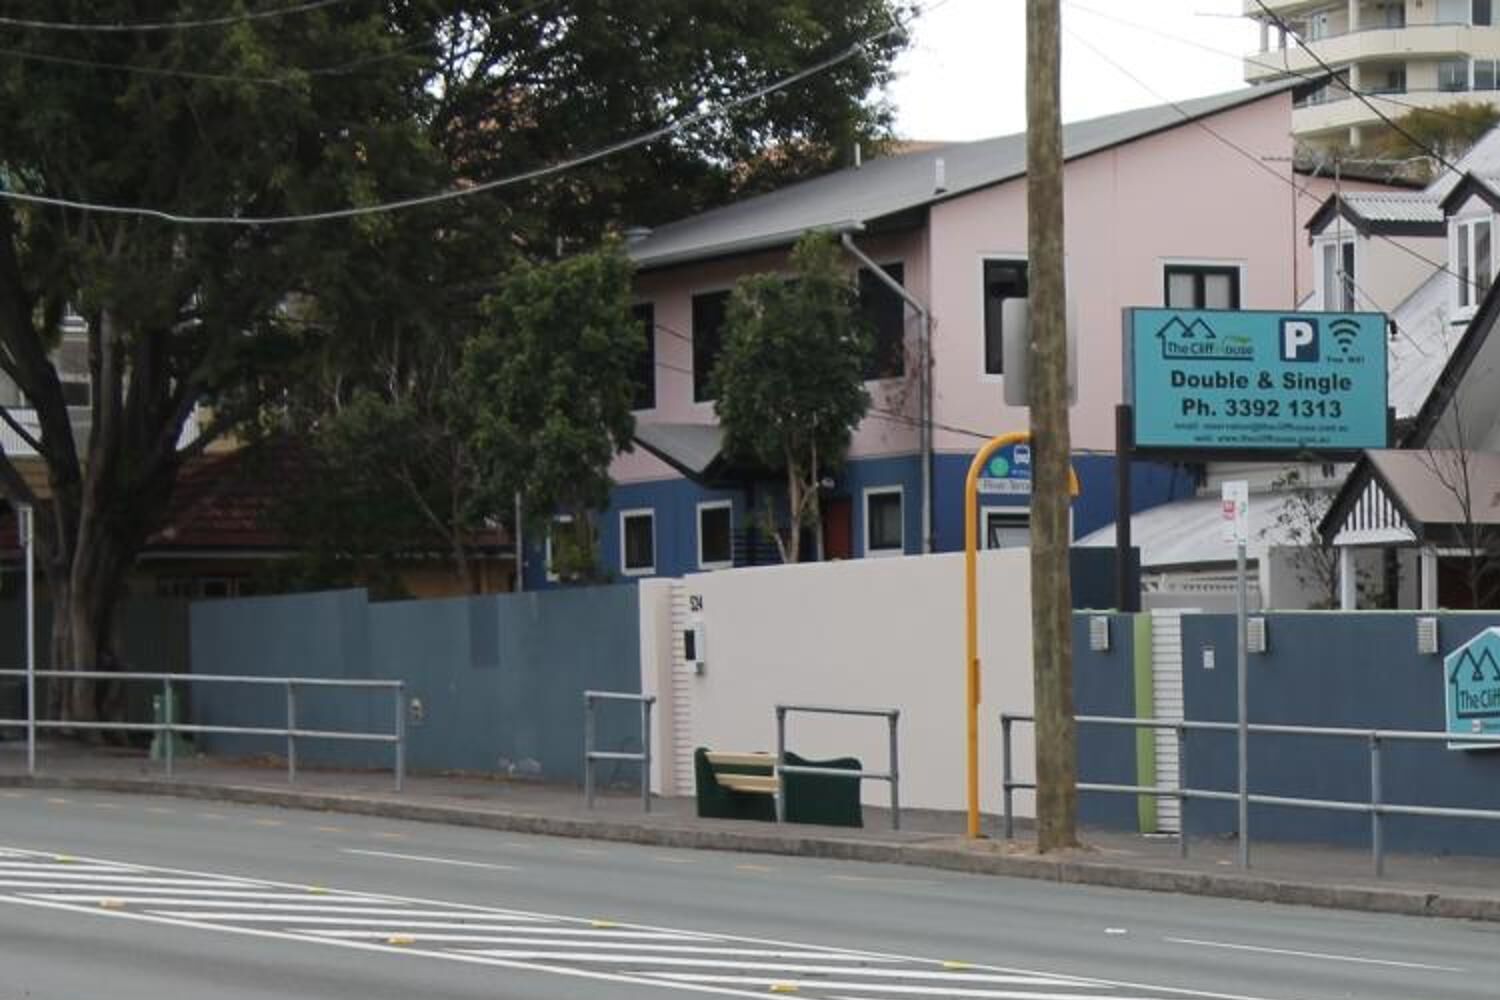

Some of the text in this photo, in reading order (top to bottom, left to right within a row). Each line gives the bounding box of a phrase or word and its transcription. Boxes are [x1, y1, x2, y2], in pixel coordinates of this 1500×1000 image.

[1285, 321, 1313, 359] P
[1171, 370, 1352, 395] Double & Single
[1181, 398, 1342, 418] Ph. 3392 1313
